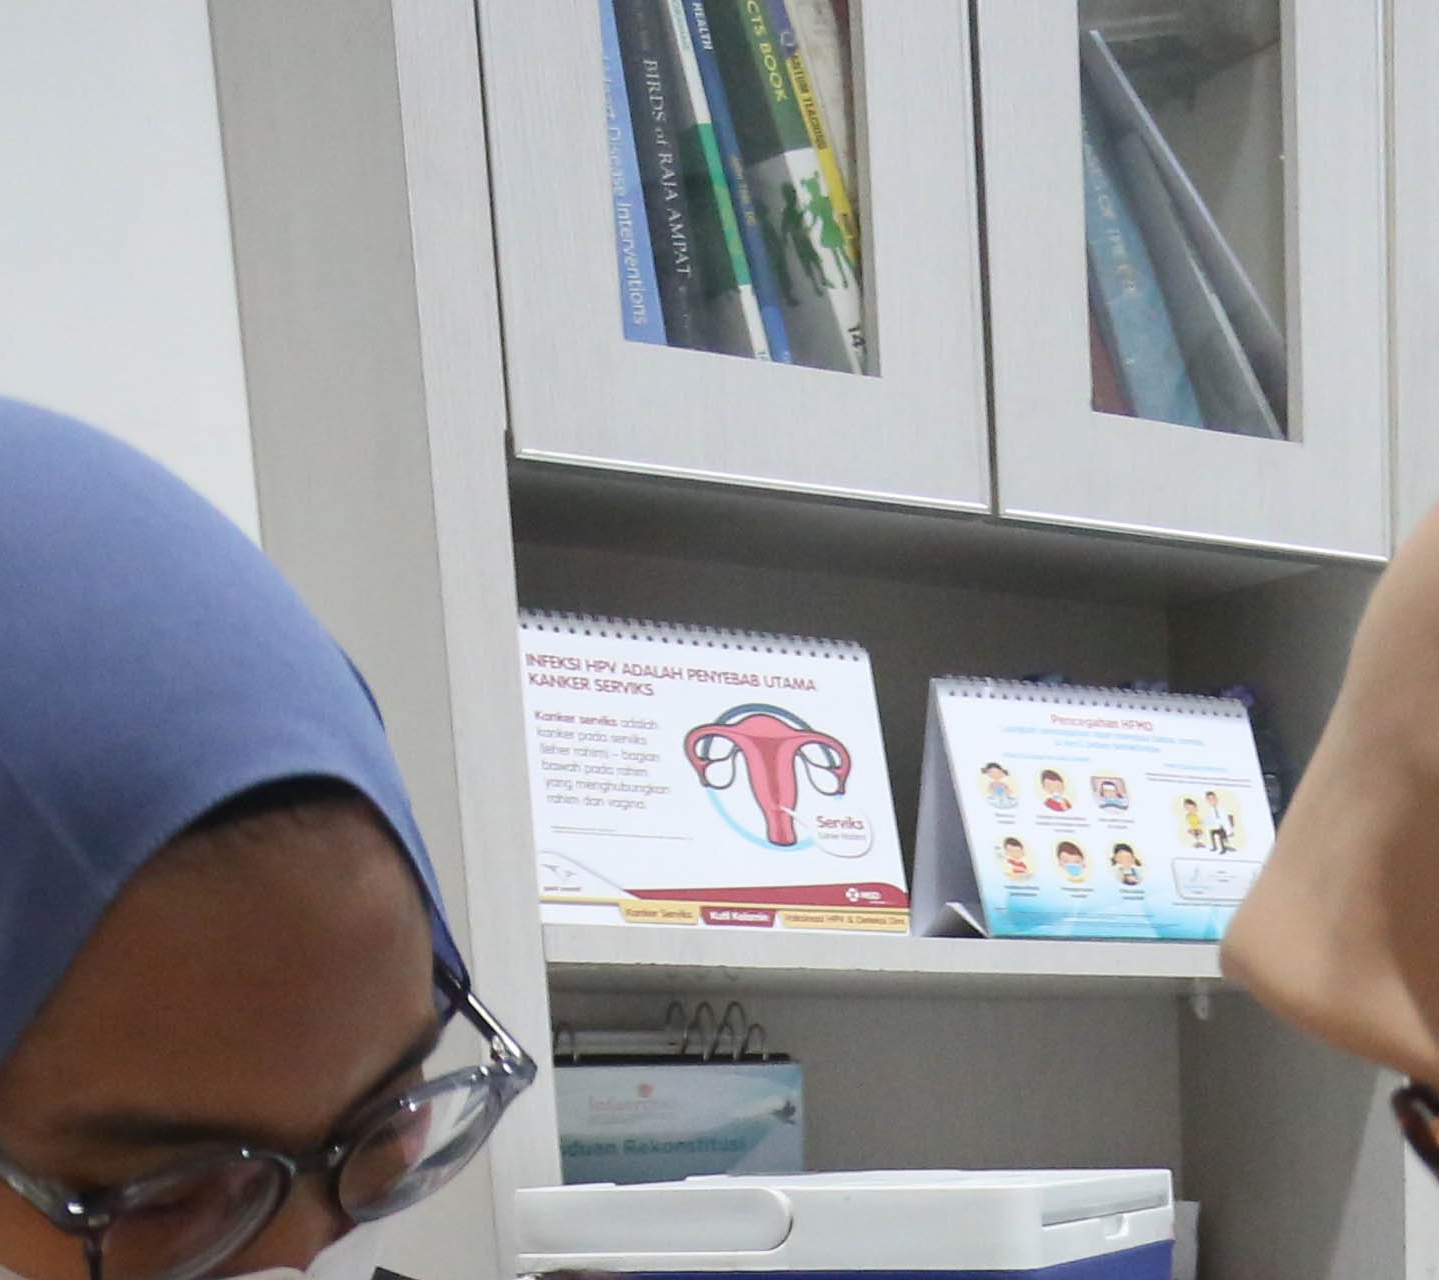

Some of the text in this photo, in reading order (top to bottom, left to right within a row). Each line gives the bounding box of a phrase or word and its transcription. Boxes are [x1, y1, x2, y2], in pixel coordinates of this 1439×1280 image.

[692, 2, 714, 50] HEALTH
[759, 41, 789, 103] BOOK
[642, 58, 667, 124] BIRDS
[655, 127, 668, 146] of
[667, 207, 692, 279] AMPAT
[618, 203, 648, 326] Interventions
[525, 653, 817, 693] INFEKSI HPV ADALAH PENYEBAB UTAMA
[528, 672, 656, 697] KANKER SERVIKS
[534, 710, 576, 724] Kanker
[1050, 713, 1120, 730] Pencegahan
[816, 815, 864, 831] Serviks
